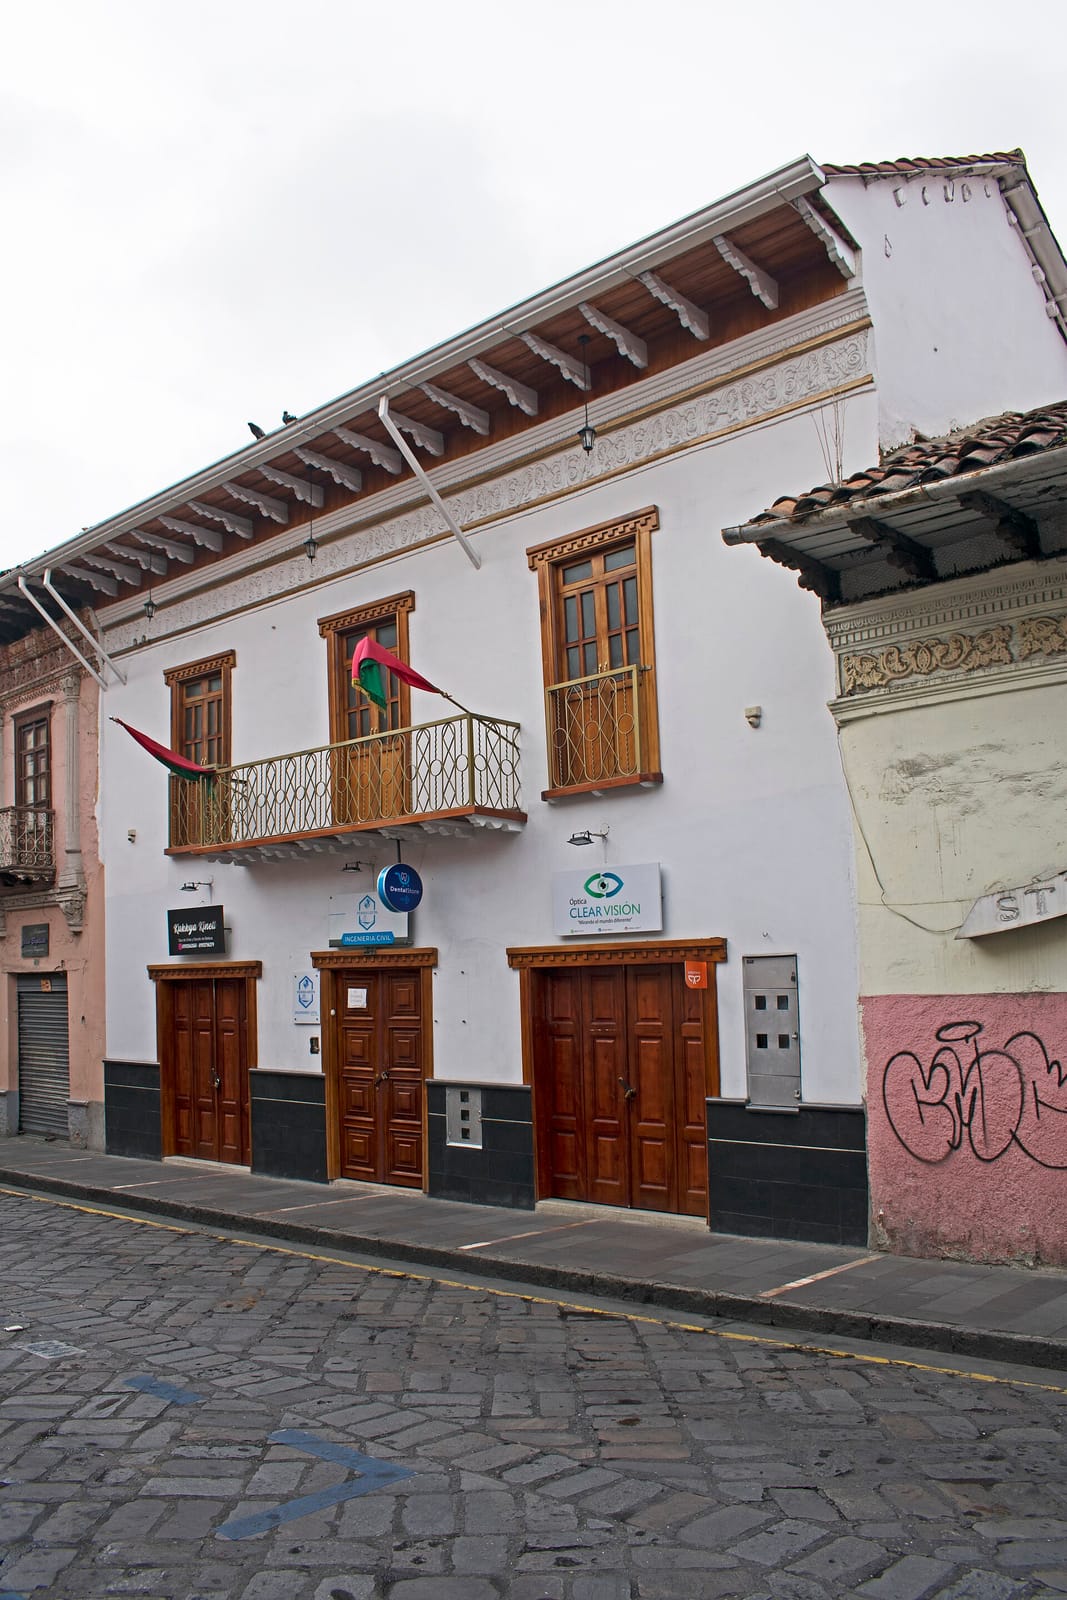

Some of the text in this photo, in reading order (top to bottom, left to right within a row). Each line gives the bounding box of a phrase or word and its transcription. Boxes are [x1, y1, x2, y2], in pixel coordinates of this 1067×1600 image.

[569, 901, 641, 918] CLEAR VISIÓN
[995, 879, 1067, 922] ST
